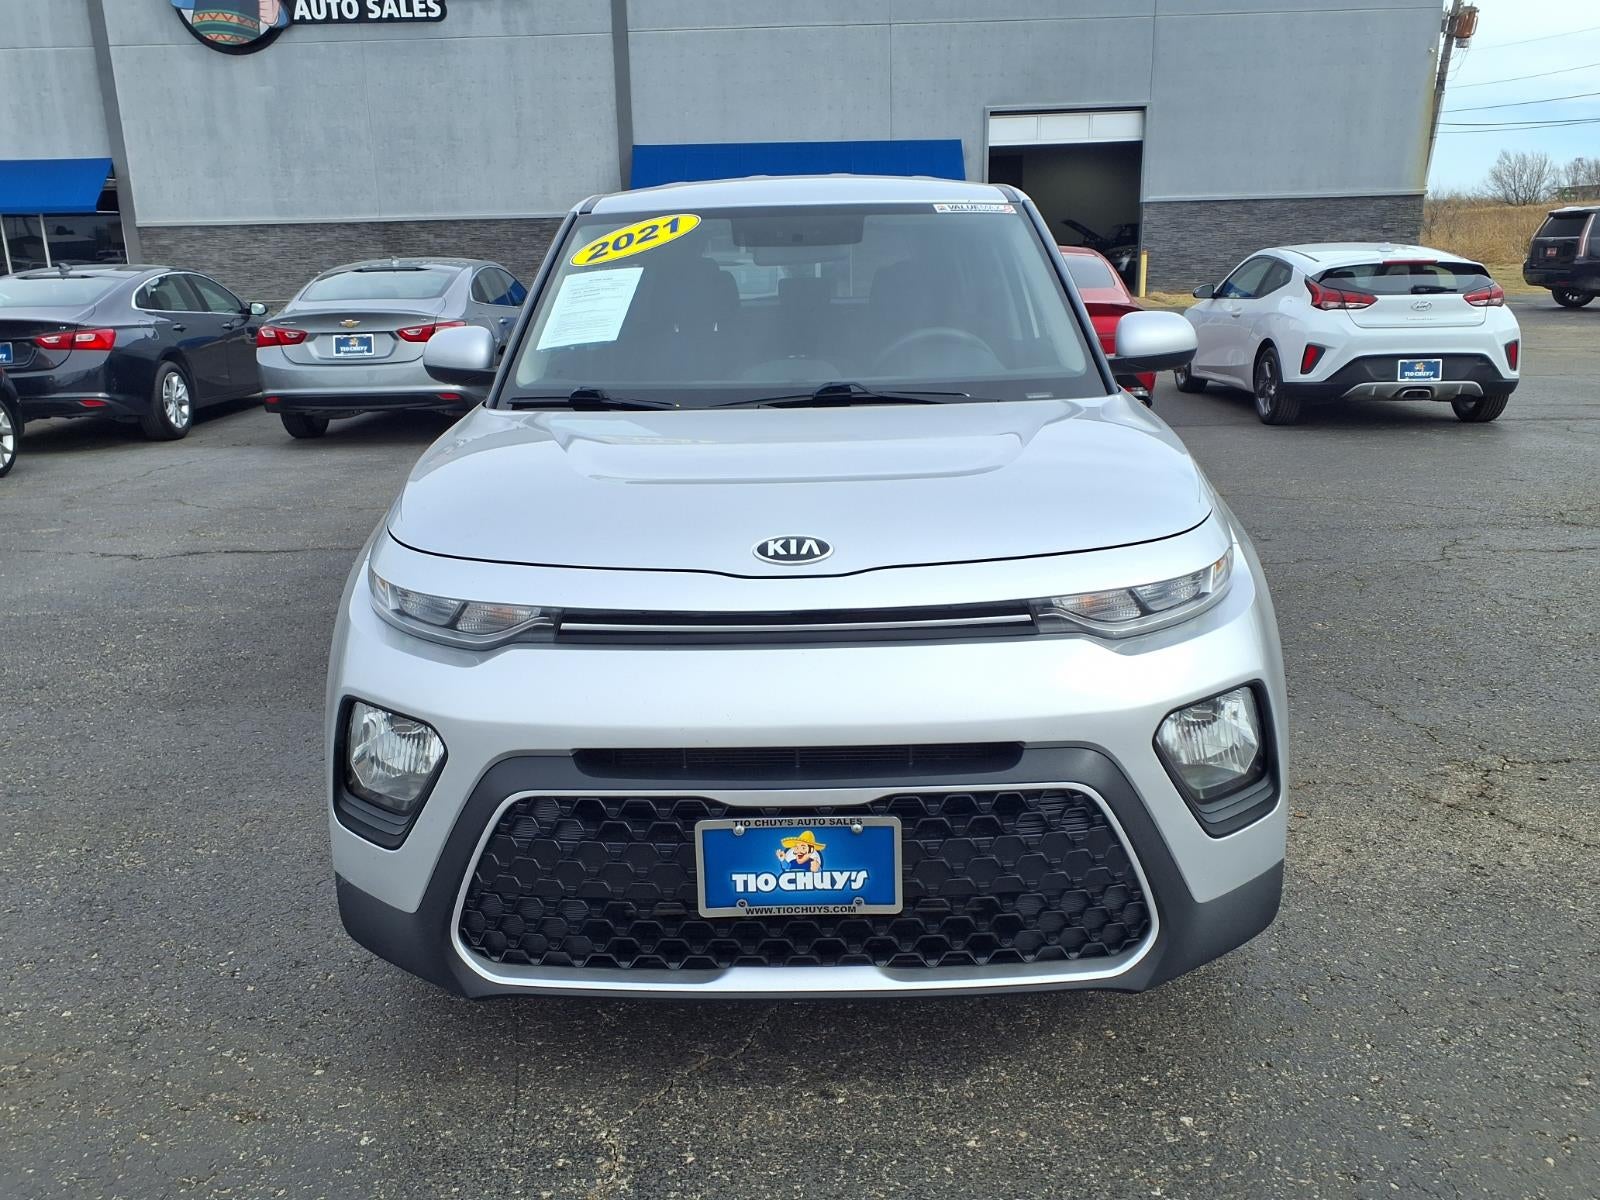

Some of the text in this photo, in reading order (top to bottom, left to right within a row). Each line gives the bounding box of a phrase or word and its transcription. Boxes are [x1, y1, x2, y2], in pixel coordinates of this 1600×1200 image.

[294, 0, 442, 20] AUTO SALES
[585, 216, 681, 262] 2021
[767, 539, 821, 556] KIA
[733, 817, 863, 828] TIO CHUY'S AUTO SALES
[745, 905, 857, 915] WWW.TIOCHUYS.COM
